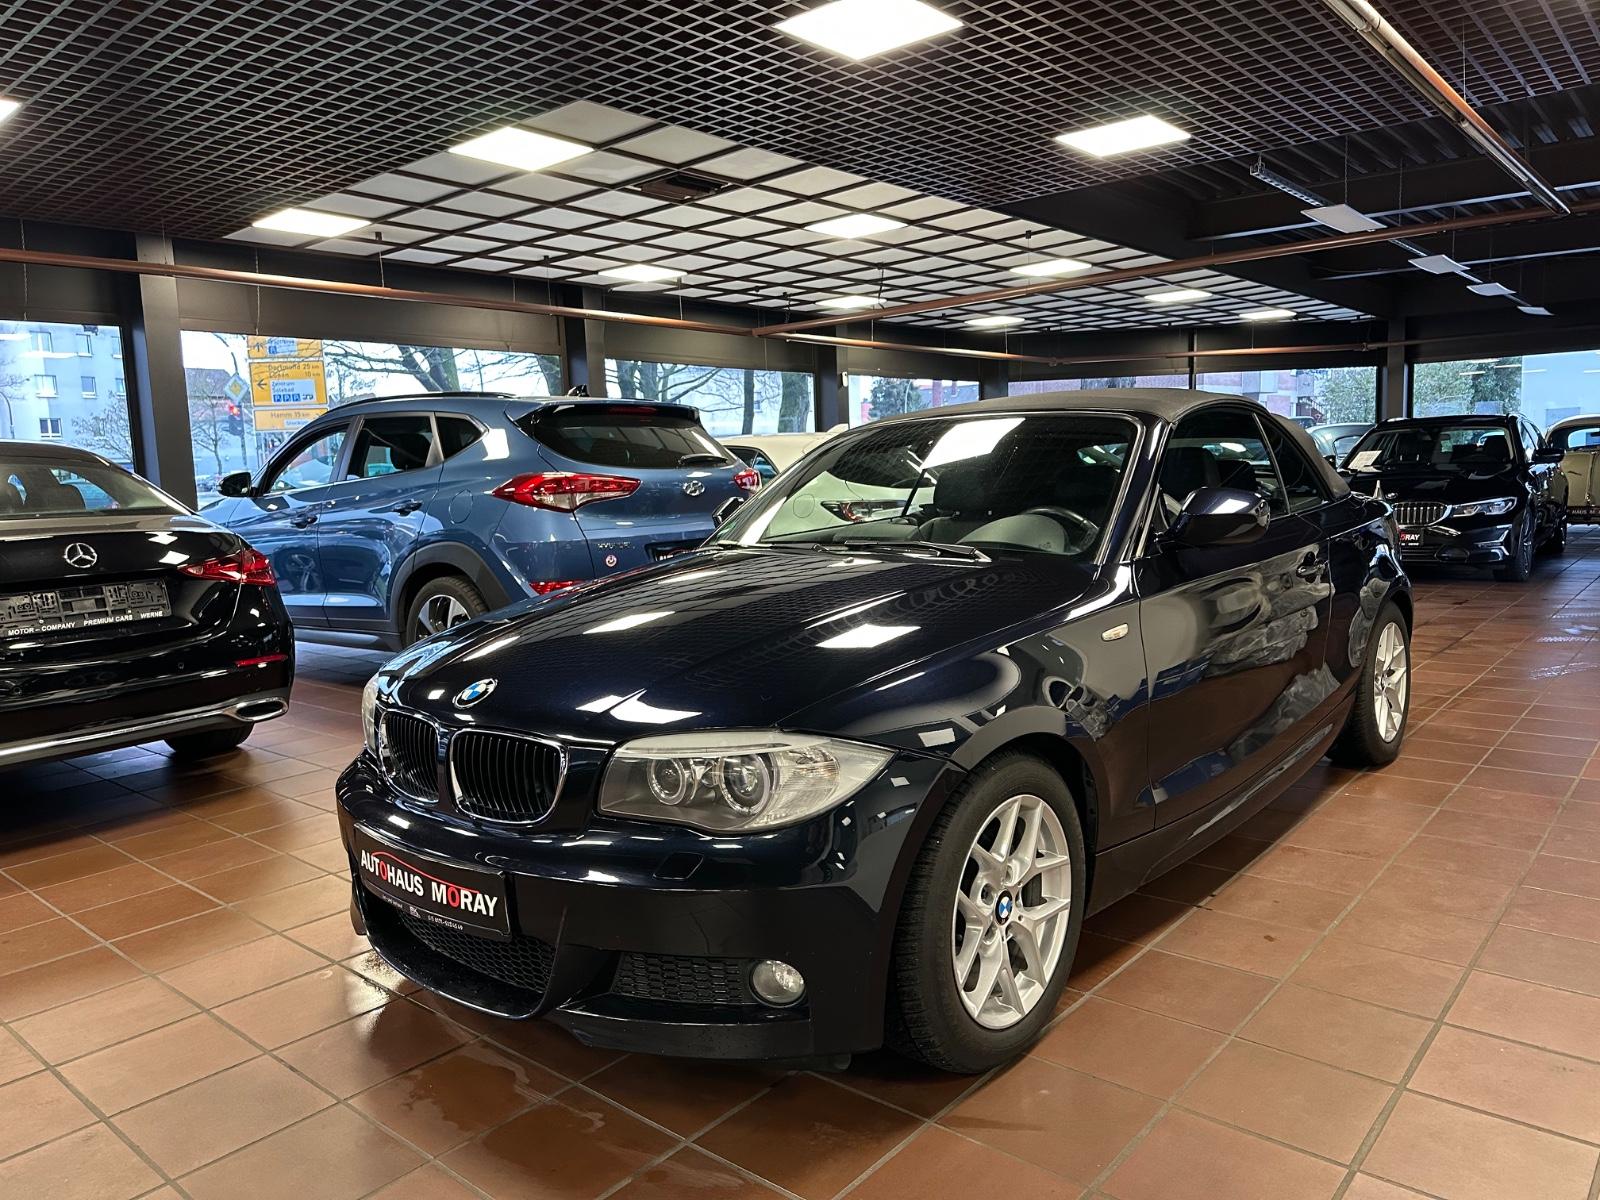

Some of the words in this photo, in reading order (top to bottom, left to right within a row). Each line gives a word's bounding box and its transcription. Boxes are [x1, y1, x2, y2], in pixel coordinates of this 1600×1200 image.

[8, 627, 35, 636] MOTOR
[41, 621, 76, 632] COMPANY
[83, 617, 115, 626] PREMIUM
[115, 614, 133, 623] CARS
[140, 611, 163, 619] WERNE
[360, 849, 424, 897] AUTOHAUS
[431, 881, 498, 917] MORAY
